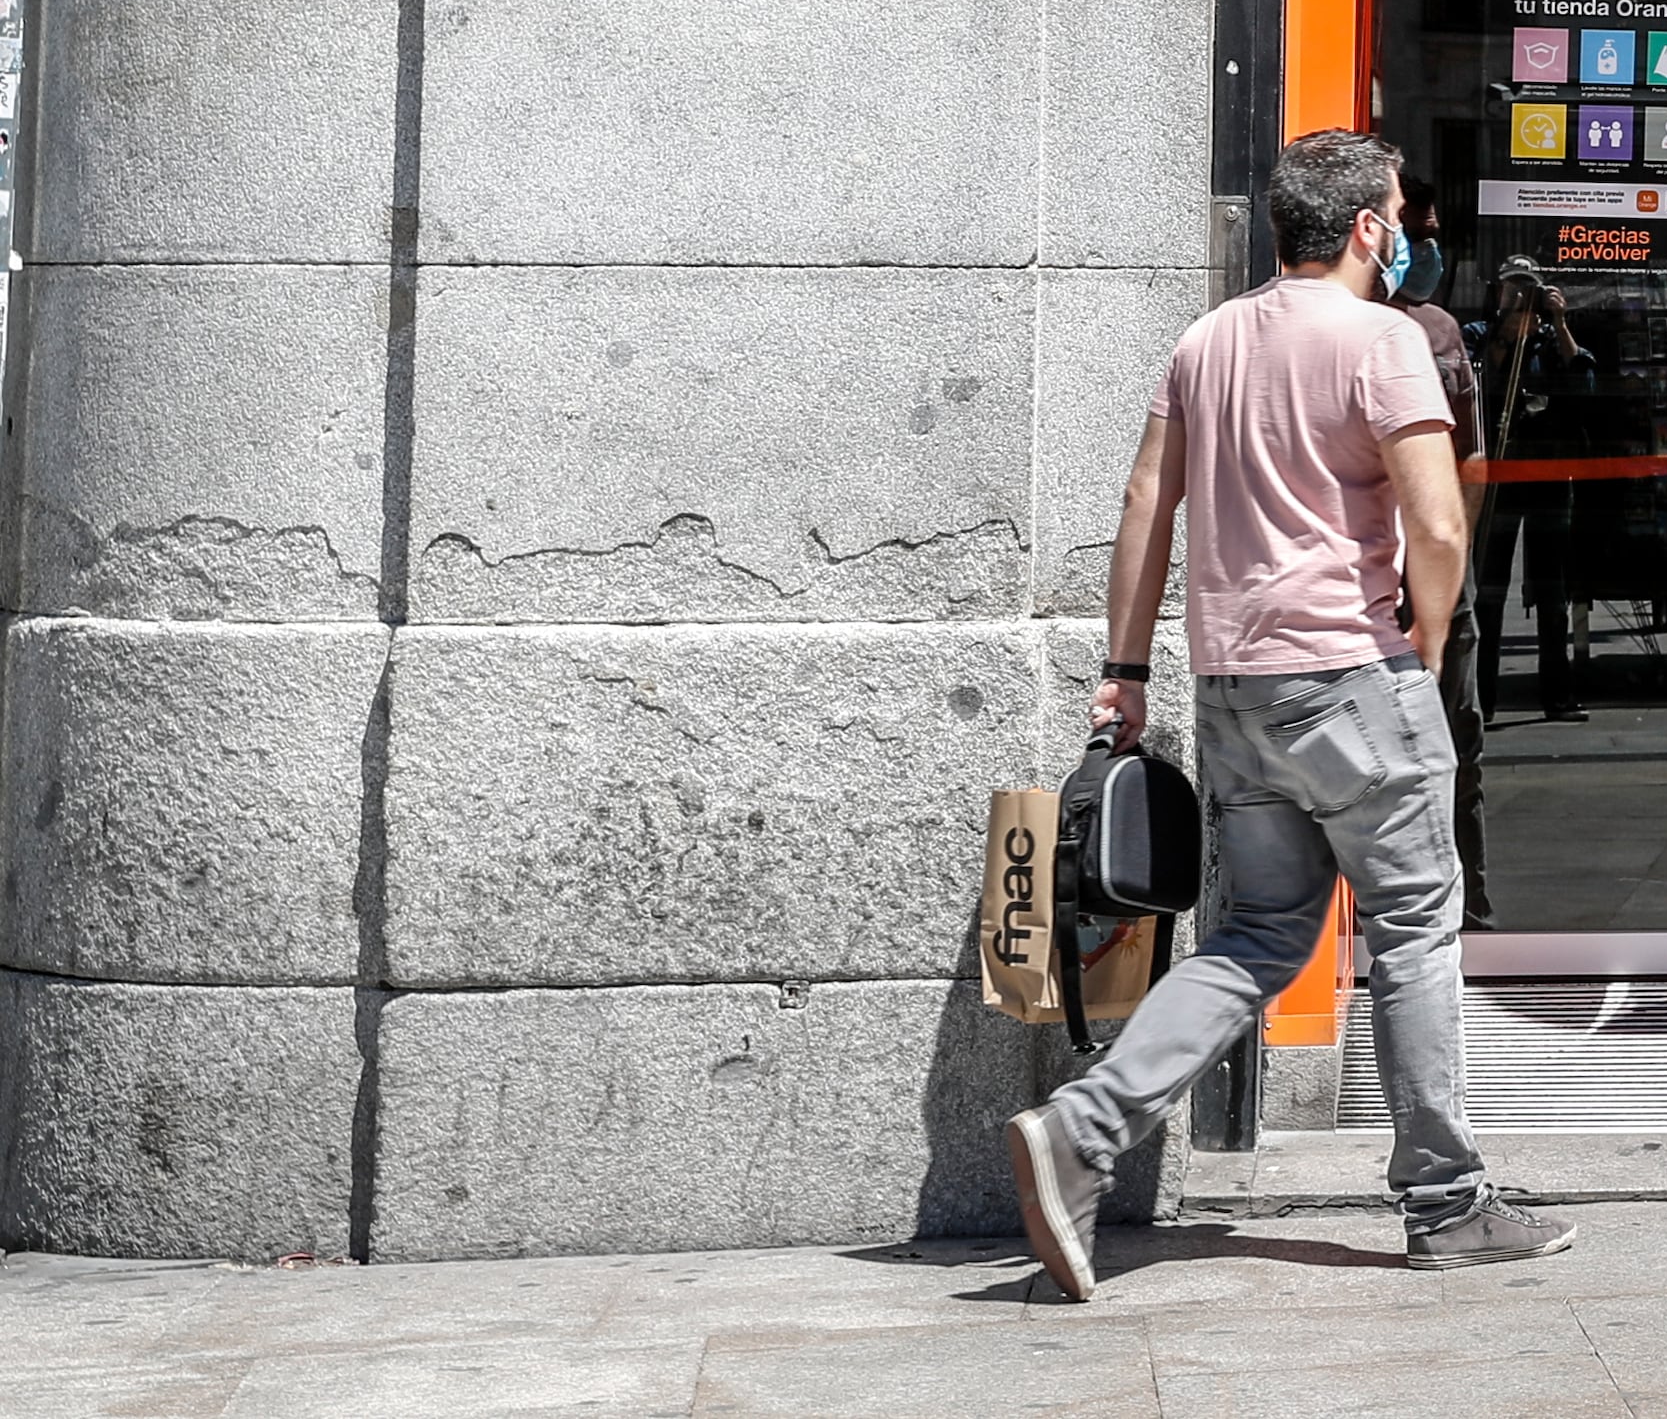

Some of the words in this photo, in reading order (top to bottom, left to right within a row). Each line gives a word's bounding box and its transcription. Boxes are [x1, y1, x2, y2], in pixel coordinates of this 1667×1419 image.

[1558, 226, 1650, 245] #Gracias
[1558, 244, 1650, 262] porVolver
[993, 827, 1035, 966] fnac
